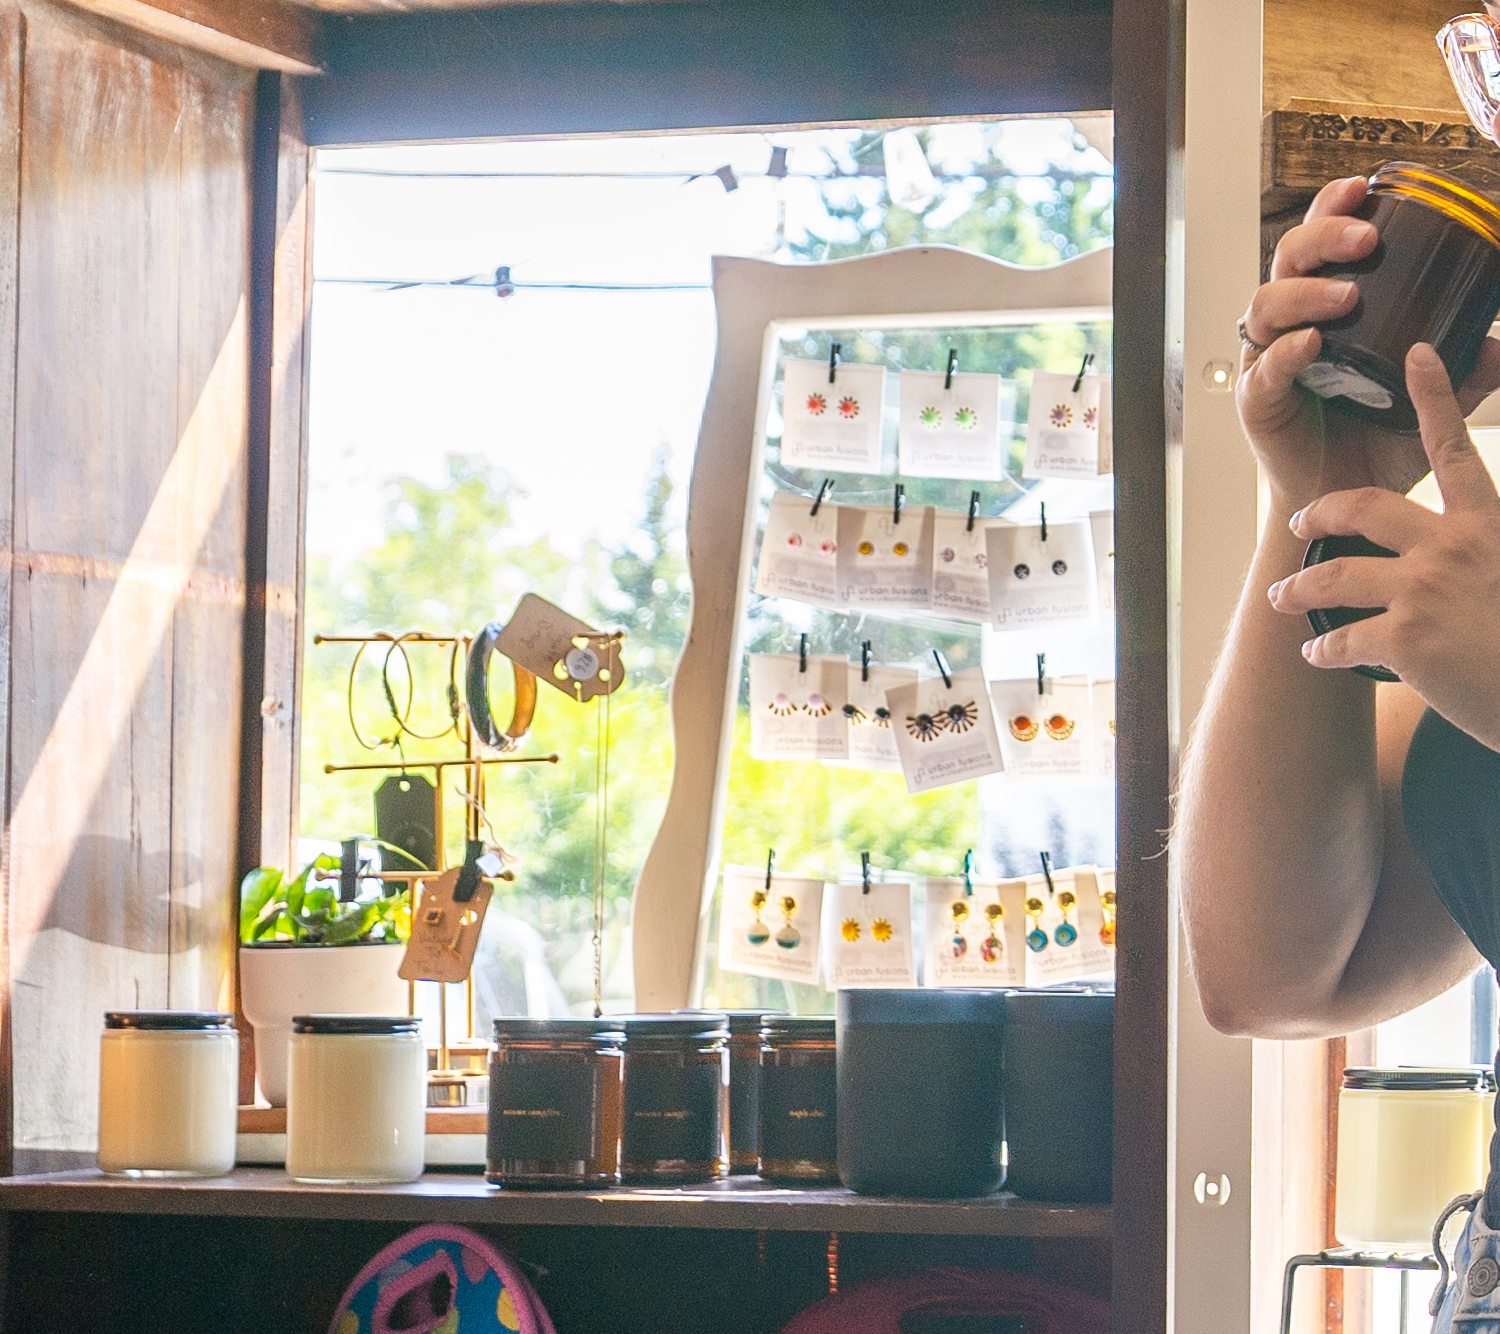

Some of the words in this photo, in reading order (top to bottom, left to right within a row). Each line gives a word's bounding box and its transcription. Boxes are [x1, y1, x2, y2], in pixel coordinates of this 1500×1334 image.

[835, 446, 868, 456] fusions
[778, 577, 808, 586] urban
[858, 586, 890, 594] urban
[891, 586, 929, 595] fusions
[1015, 606, 1048, 616] urban
[1052, 603, 1090, 614] fusions
[928, 761, 956, 774] urban
[958, 753, 992, 766] fusions
[876, 967, 909, 975] fusions
